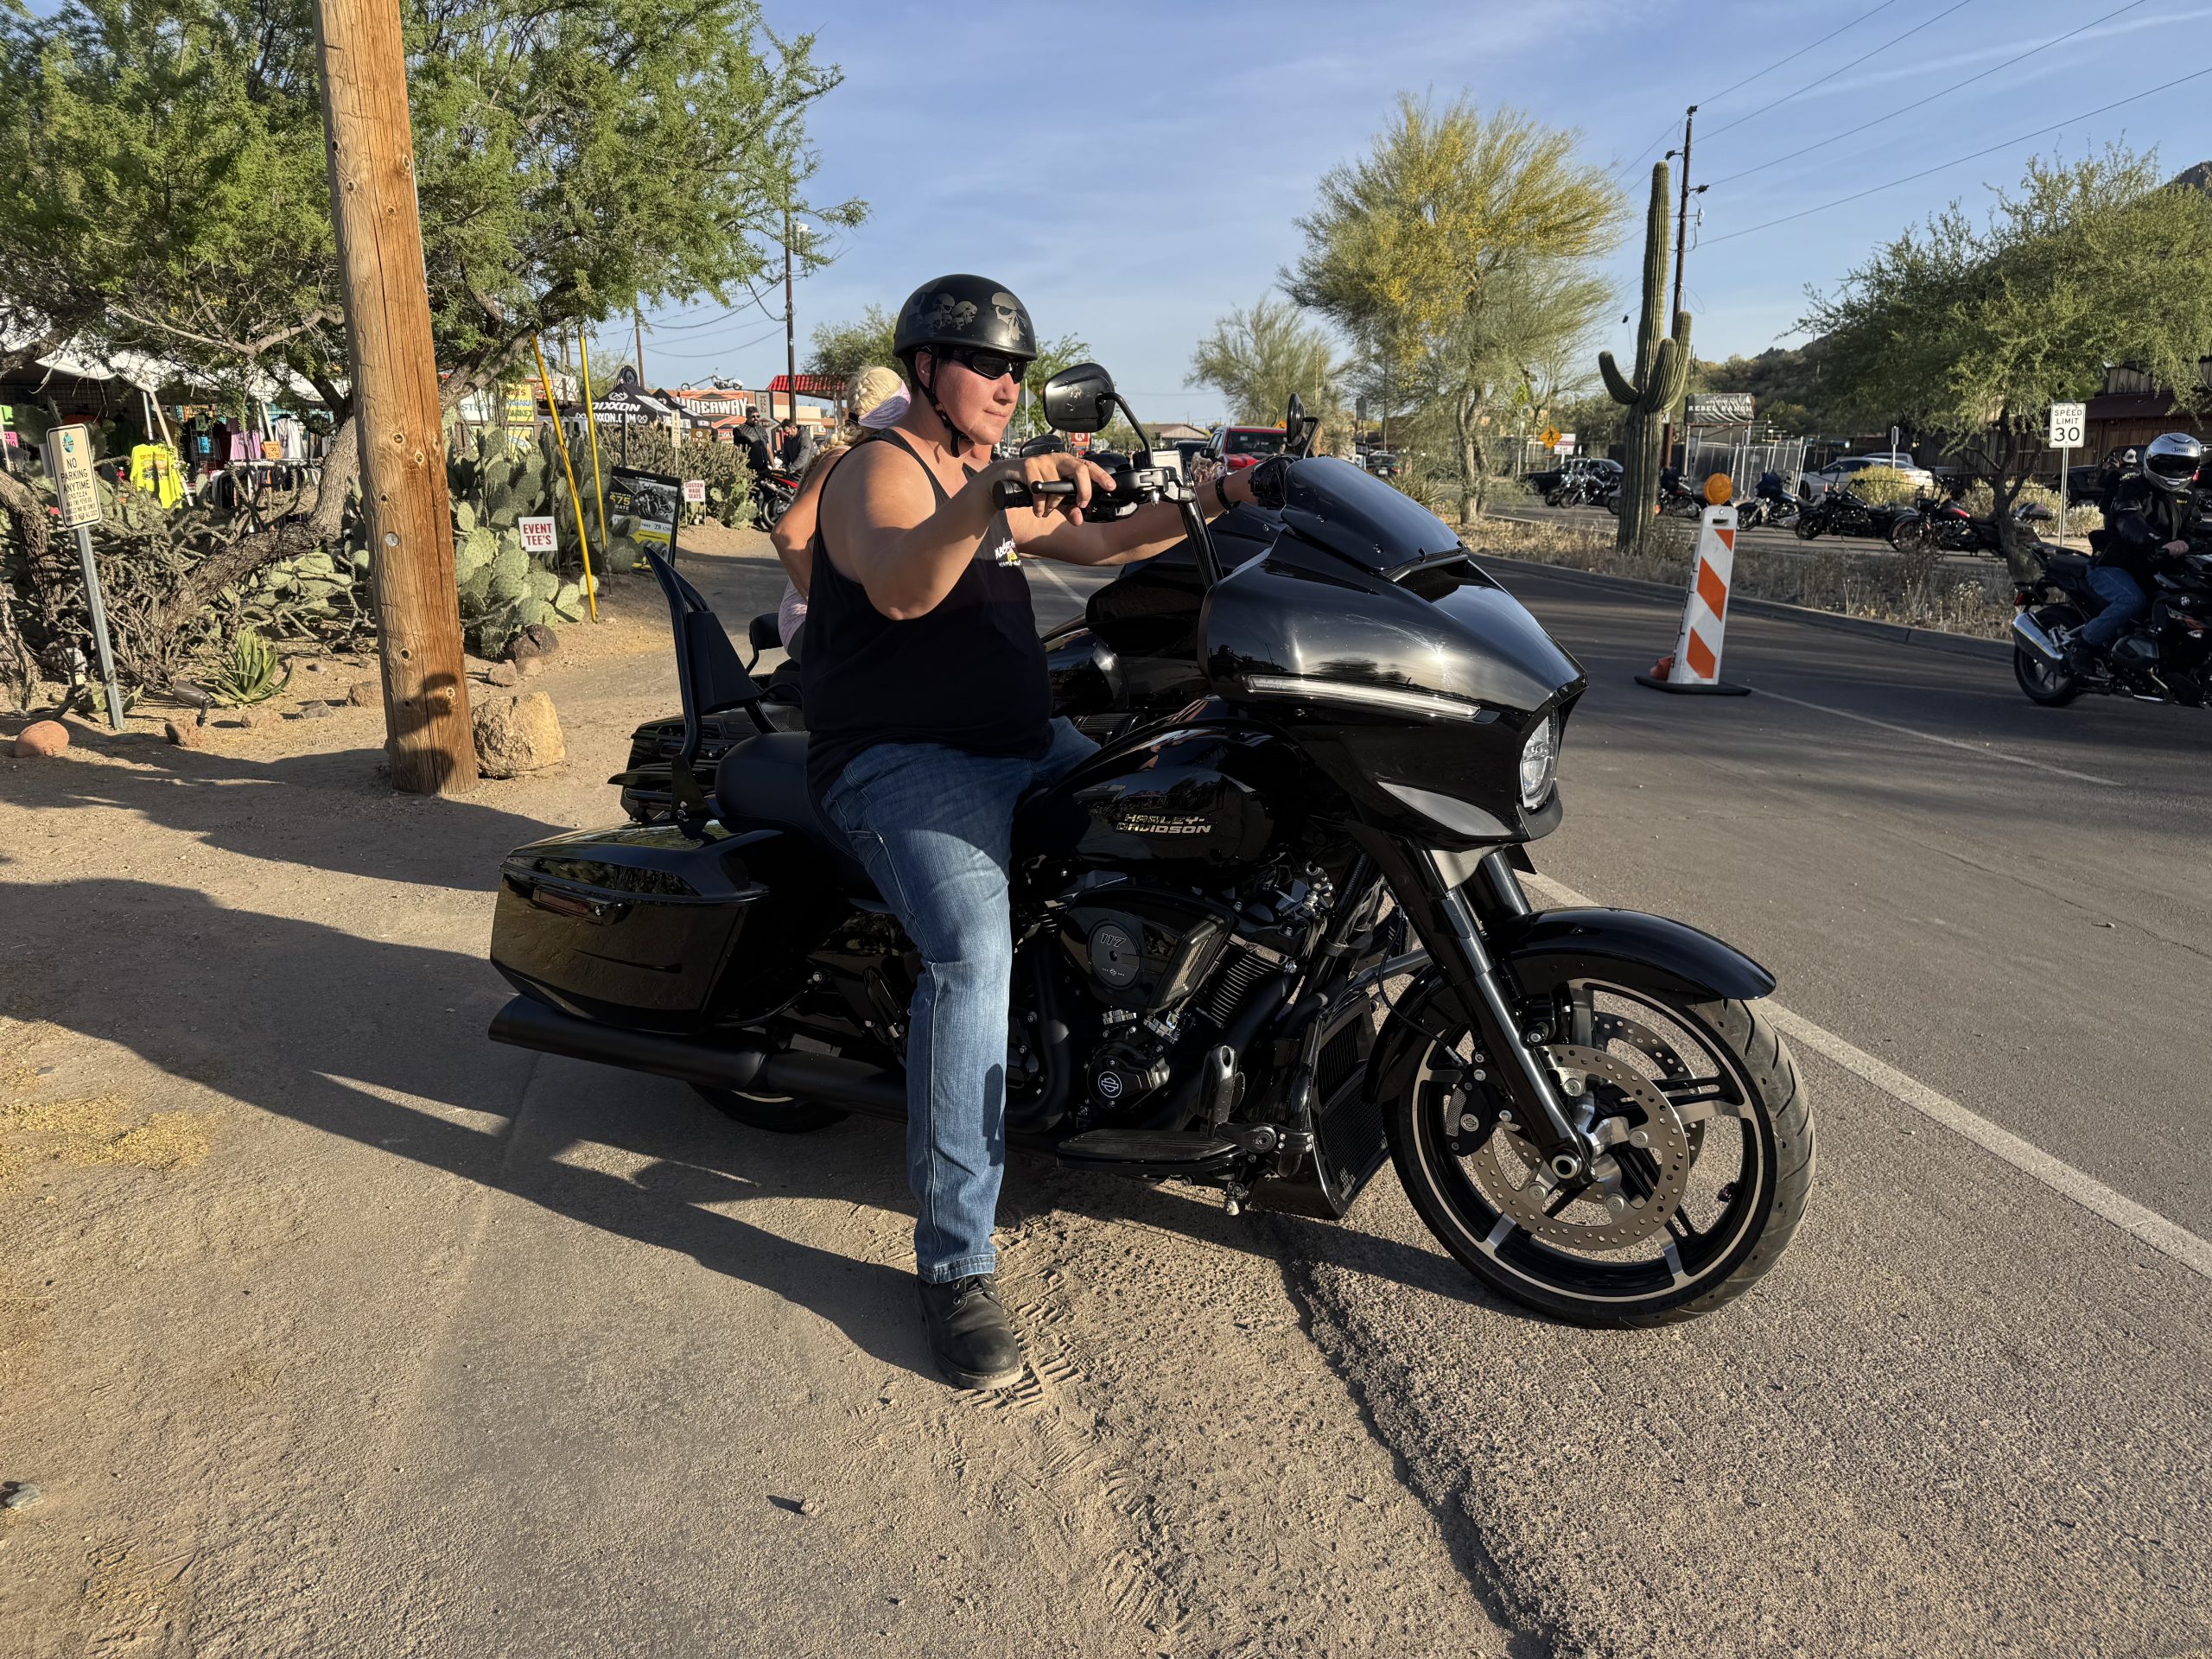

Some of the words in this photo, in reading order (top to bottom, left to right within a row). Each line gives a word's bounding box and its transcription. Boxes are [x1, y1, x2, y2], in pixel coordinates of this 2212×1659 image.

[593, 412, 637, 423] IXXON.CM
[2054, 427, 2080, 442] 30
[67, 458, 77, 469] NO
[60, 469, 87, 482] PARKING
[63, 480, 90, 493] ANYTIME
[609, 493, 631, 506] $75
[523, 523, 553, 534] EVENT
[526, 535, 552, 545] TEE'S
[1116, 822, 1211, 834] DAVIDSON
[1100, 932, 1127, 948] 117
